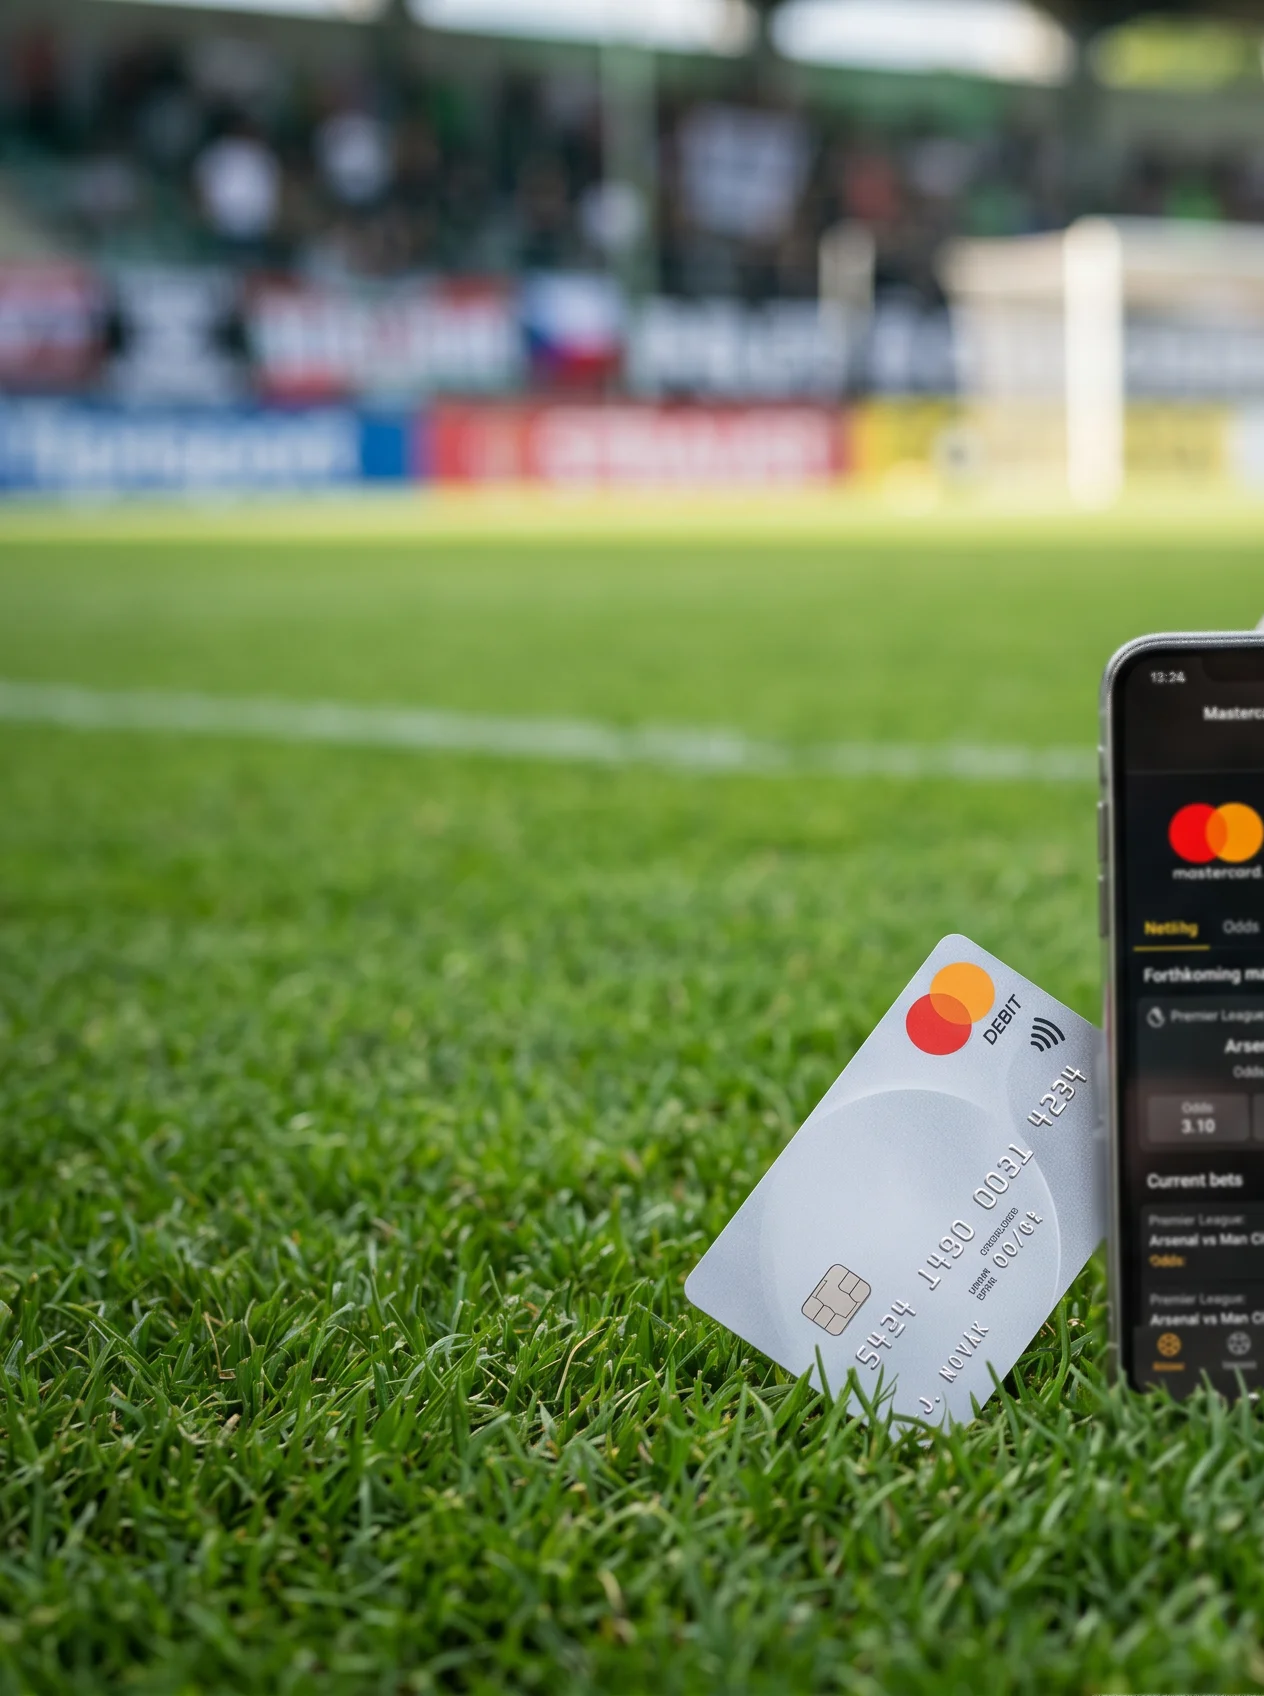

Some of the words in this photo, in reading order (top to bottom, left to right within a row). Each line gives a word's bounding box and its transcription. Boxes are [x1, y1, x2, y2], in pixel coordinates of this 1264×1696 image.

[1223, 919, 1260, 935] Odds
[982, 994, 1022, 1045] DEBIT
[1170, 1009, 1219, 1023] Premier
[1027, 1065, 1087, 1128] 4234
[1181, 1118, 1216, 1134] 3.10
[1147, 1173, 1207, 1189] Current
[1209, 1172, 1243, 1188] bets
[1148, 1214, 1195, 1227] Premier
[1149, 1233, 1199, 1247] Arsenal
[1202, 1235, 1217, 1246] vs
[1220, 1233, 1248, 1246] Man
[1150, 1312, 1200, 1326] Arsenal
[1203, 1314, 1218, 1326] vs
[1220, 1312, 1249, 1325] Man
